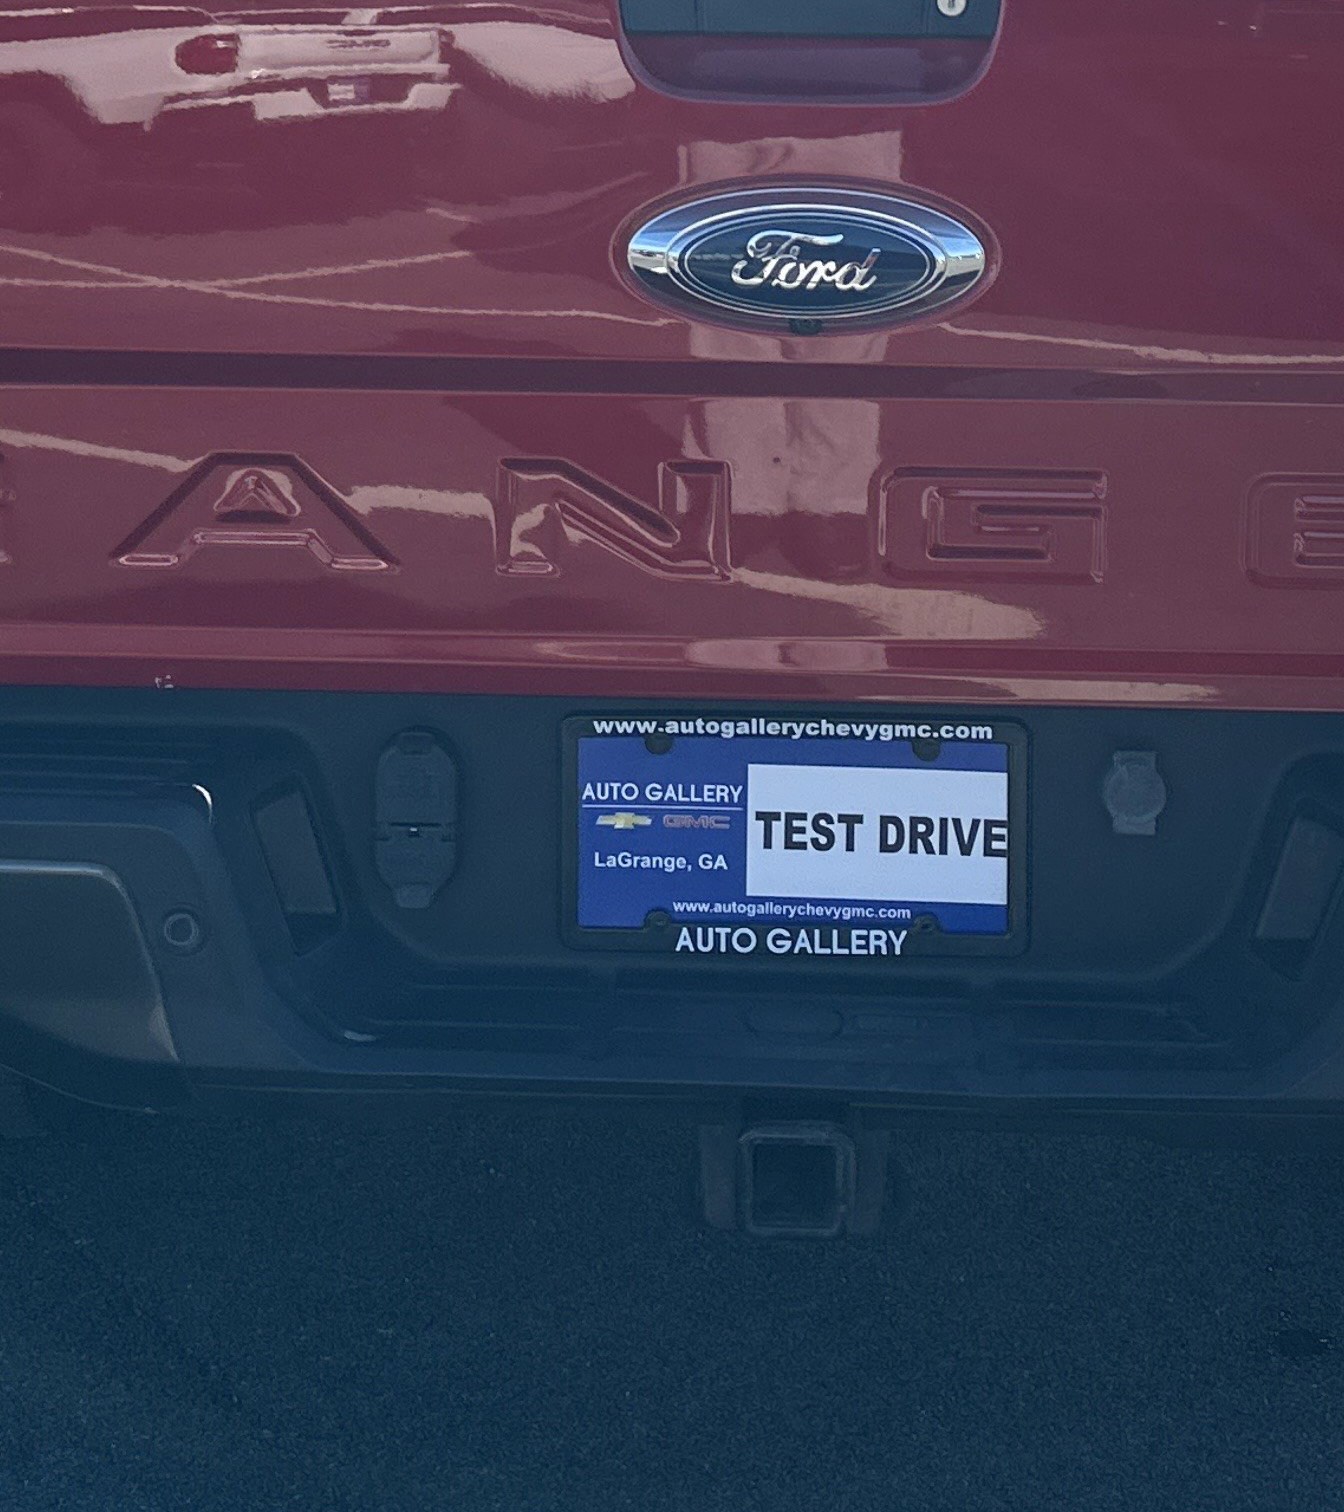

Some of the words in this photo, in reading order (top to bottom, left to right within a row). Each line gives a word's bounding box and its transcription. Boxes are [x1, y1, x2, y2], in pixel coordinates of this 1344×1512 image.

[731, 228, 881, 291] Ford
[593, 718, 993, 740] www.autogallerychevygmc.com
[582, 782, 639, 802] AUTO
[645, 784, 743, 803] GALLERY
[663, 814, 731, 829] GMC
[755, 811, 864, 852] TEST
[879, 814, 1008, 858] DRIVE
[594, 852, 692, 872] LaGrange,
[698, 853, 728, 870] GA
[673, 899, 911, 920] www.autogallerychevygmc.com
[675, 928, 757, 954] AUTO
[766, 929, 908, 956] GALLERY
